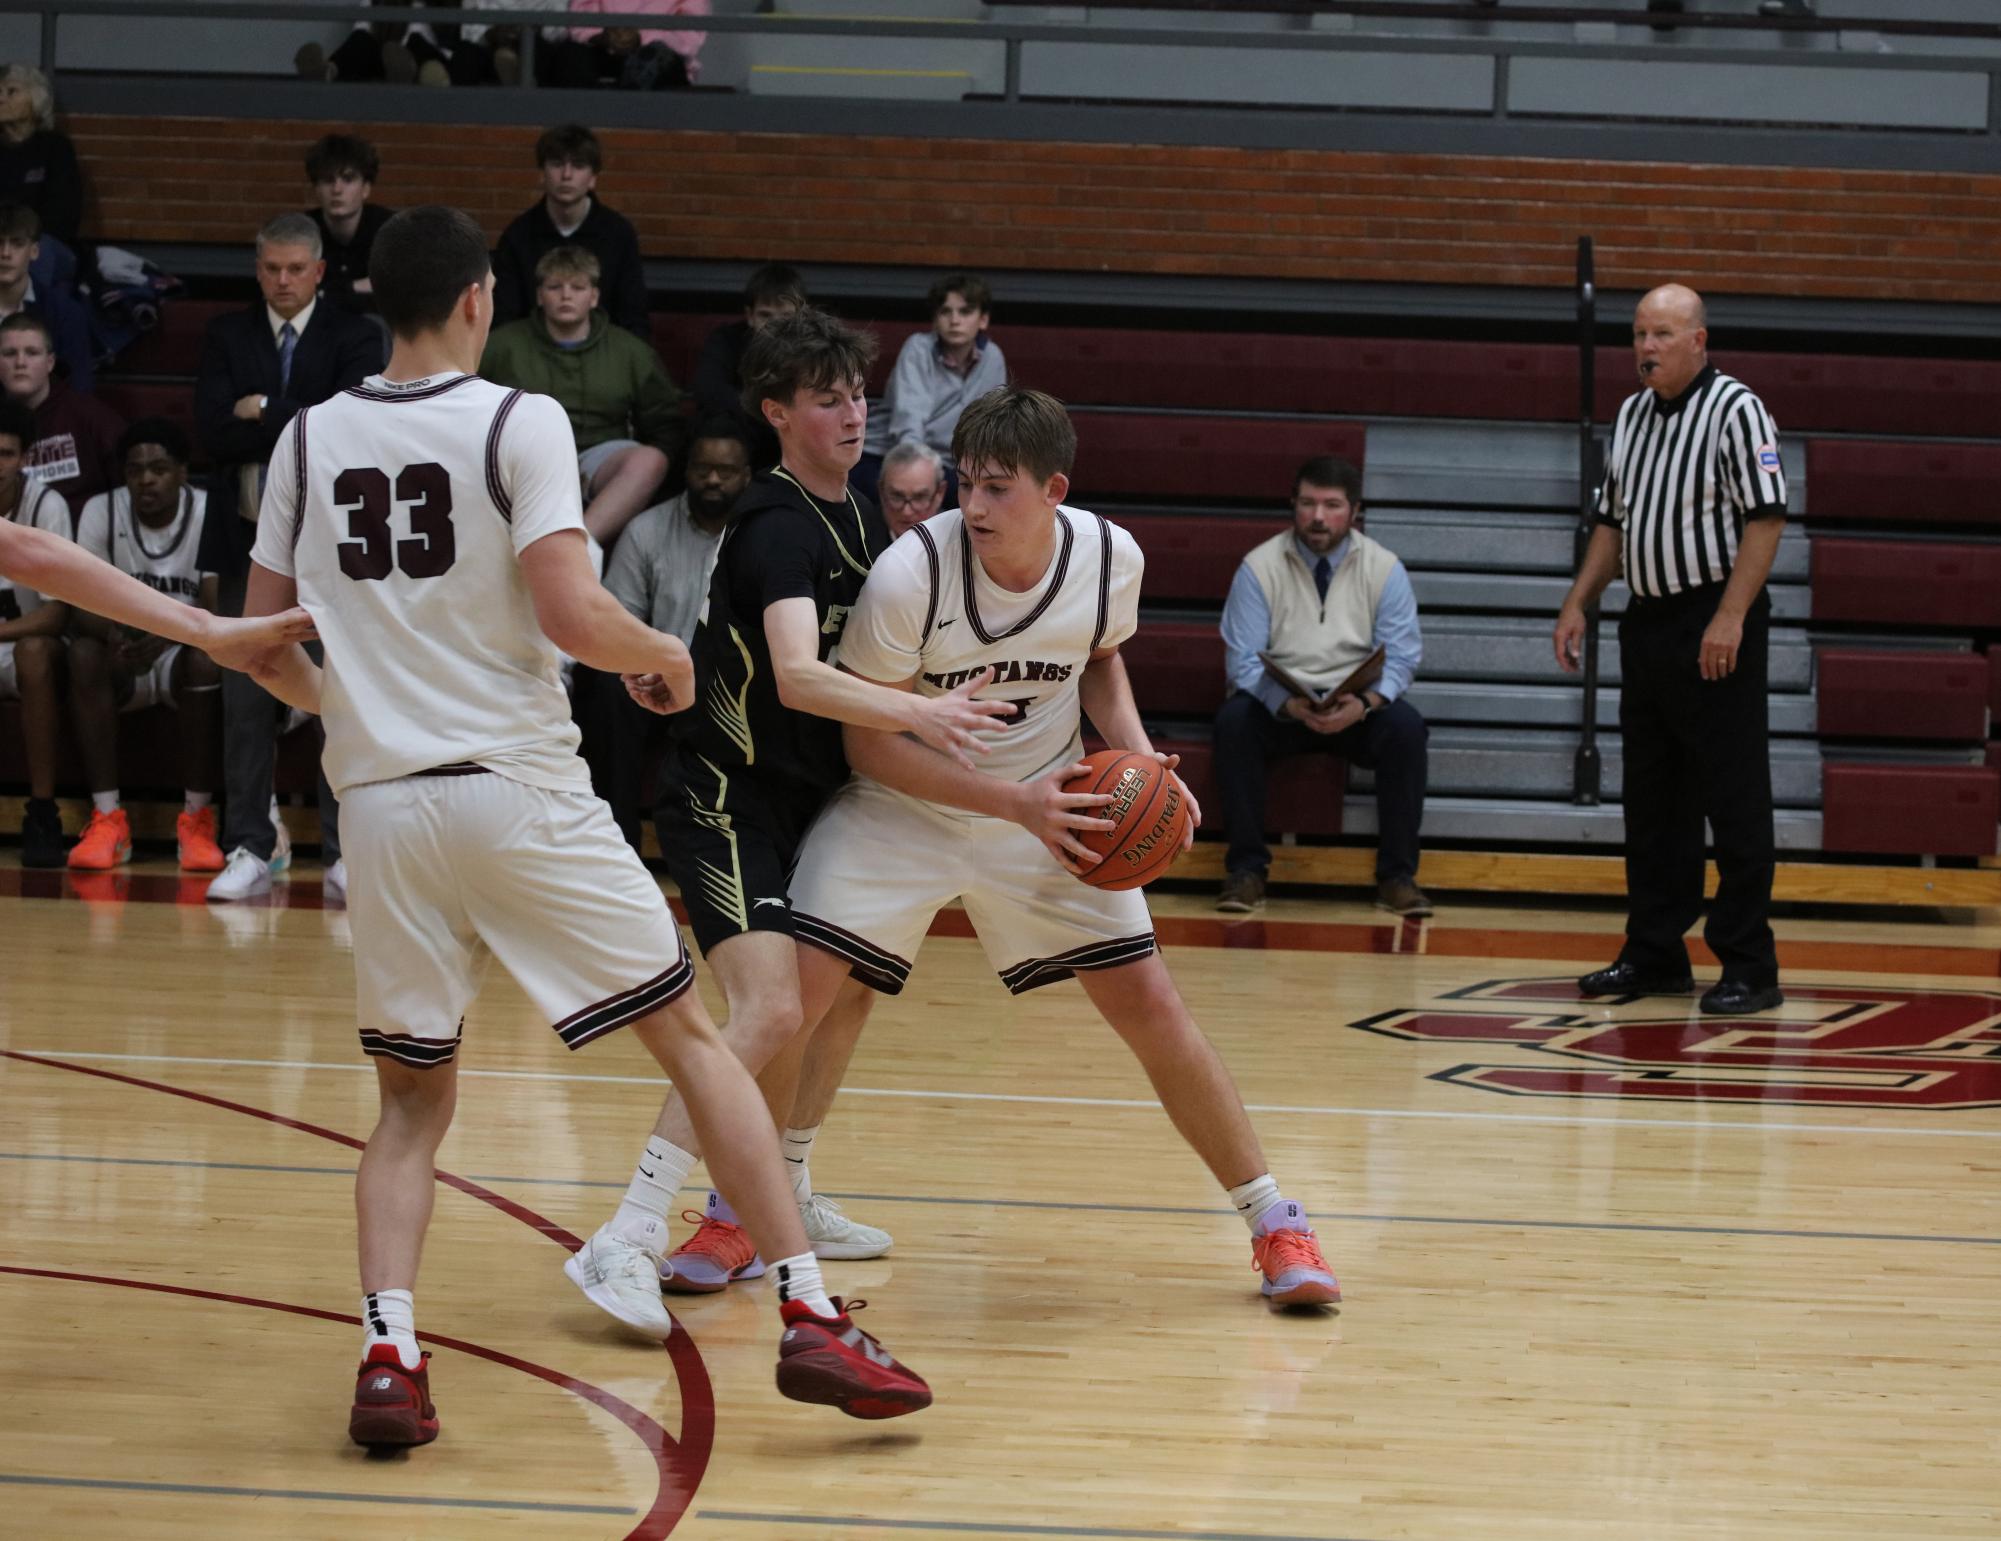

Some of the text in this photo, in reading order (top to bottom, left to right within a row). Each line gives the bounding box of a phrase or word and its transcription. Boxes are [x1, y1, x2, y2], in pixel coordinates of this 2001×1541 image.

[406, 379, 431, 391] PRO
[333, 462, 456, 581] 33
[1105, 767, 1153, 839] LEGAC
[1121, 782, 1181, 867] SPALDING
